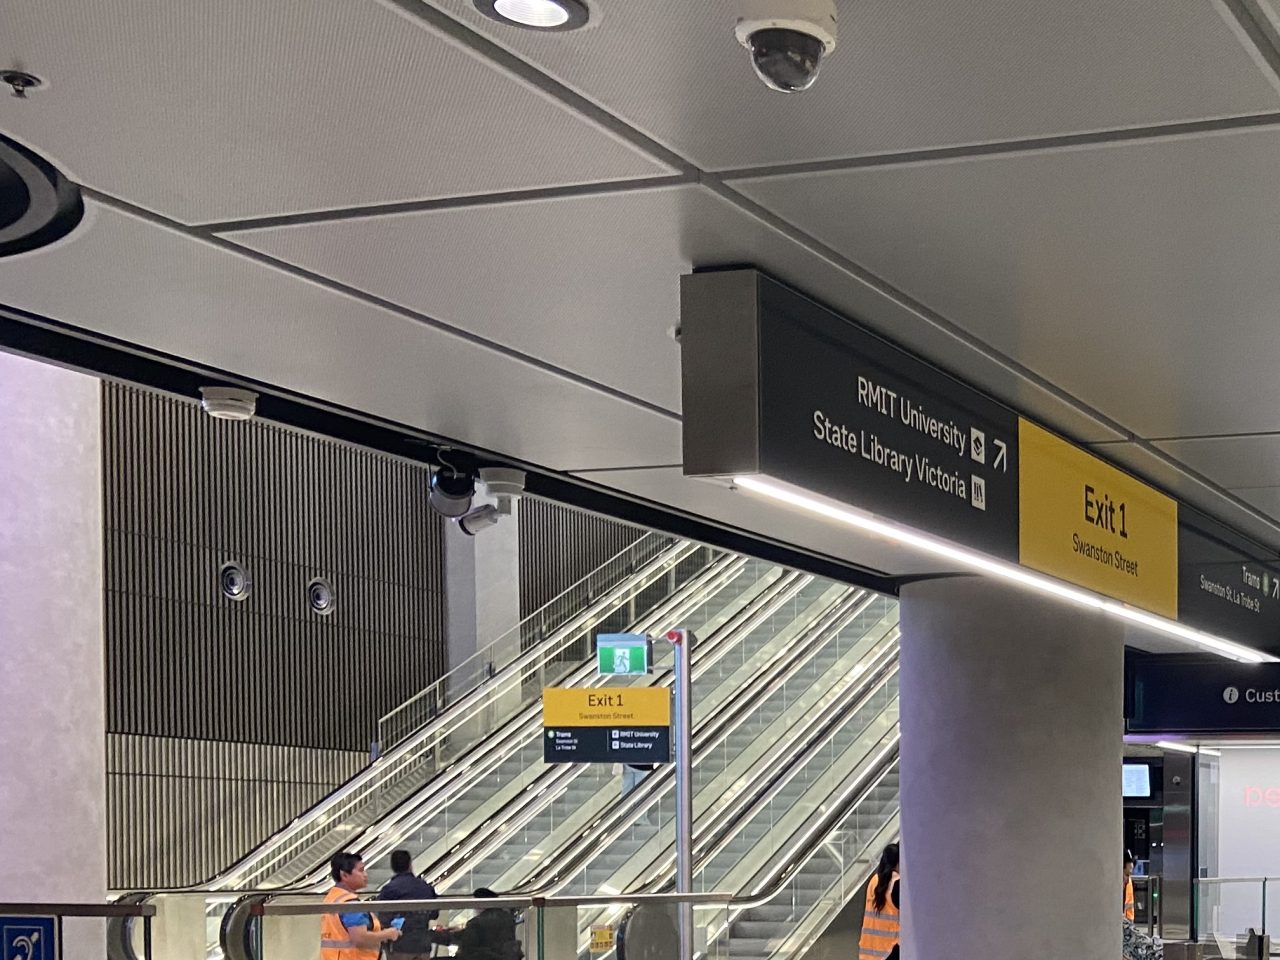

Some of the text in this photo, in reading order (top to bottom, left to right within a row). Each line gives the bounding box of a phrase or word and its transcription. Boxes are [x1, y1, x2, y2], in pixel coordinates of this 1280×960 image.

[857, 375, 966, 457] RMIT University
[813, 410, 967, 500] State Library Victoria
[1084, 484, 1128, 539] Exit 1
[1072, 533, 1138, 577] Swanston Street
[1200, 574, 1225, 598] Swanston
[1233, 589, 1240, 605] La
[1240, 592, 1254, 610] Trobe
[1254, 599, 1260, 613] St
[1242, 566, 1260, 590] Trams
[579, 712, 634, 721] Swanston Street
[588, 694, 624, 707] Exit 1
